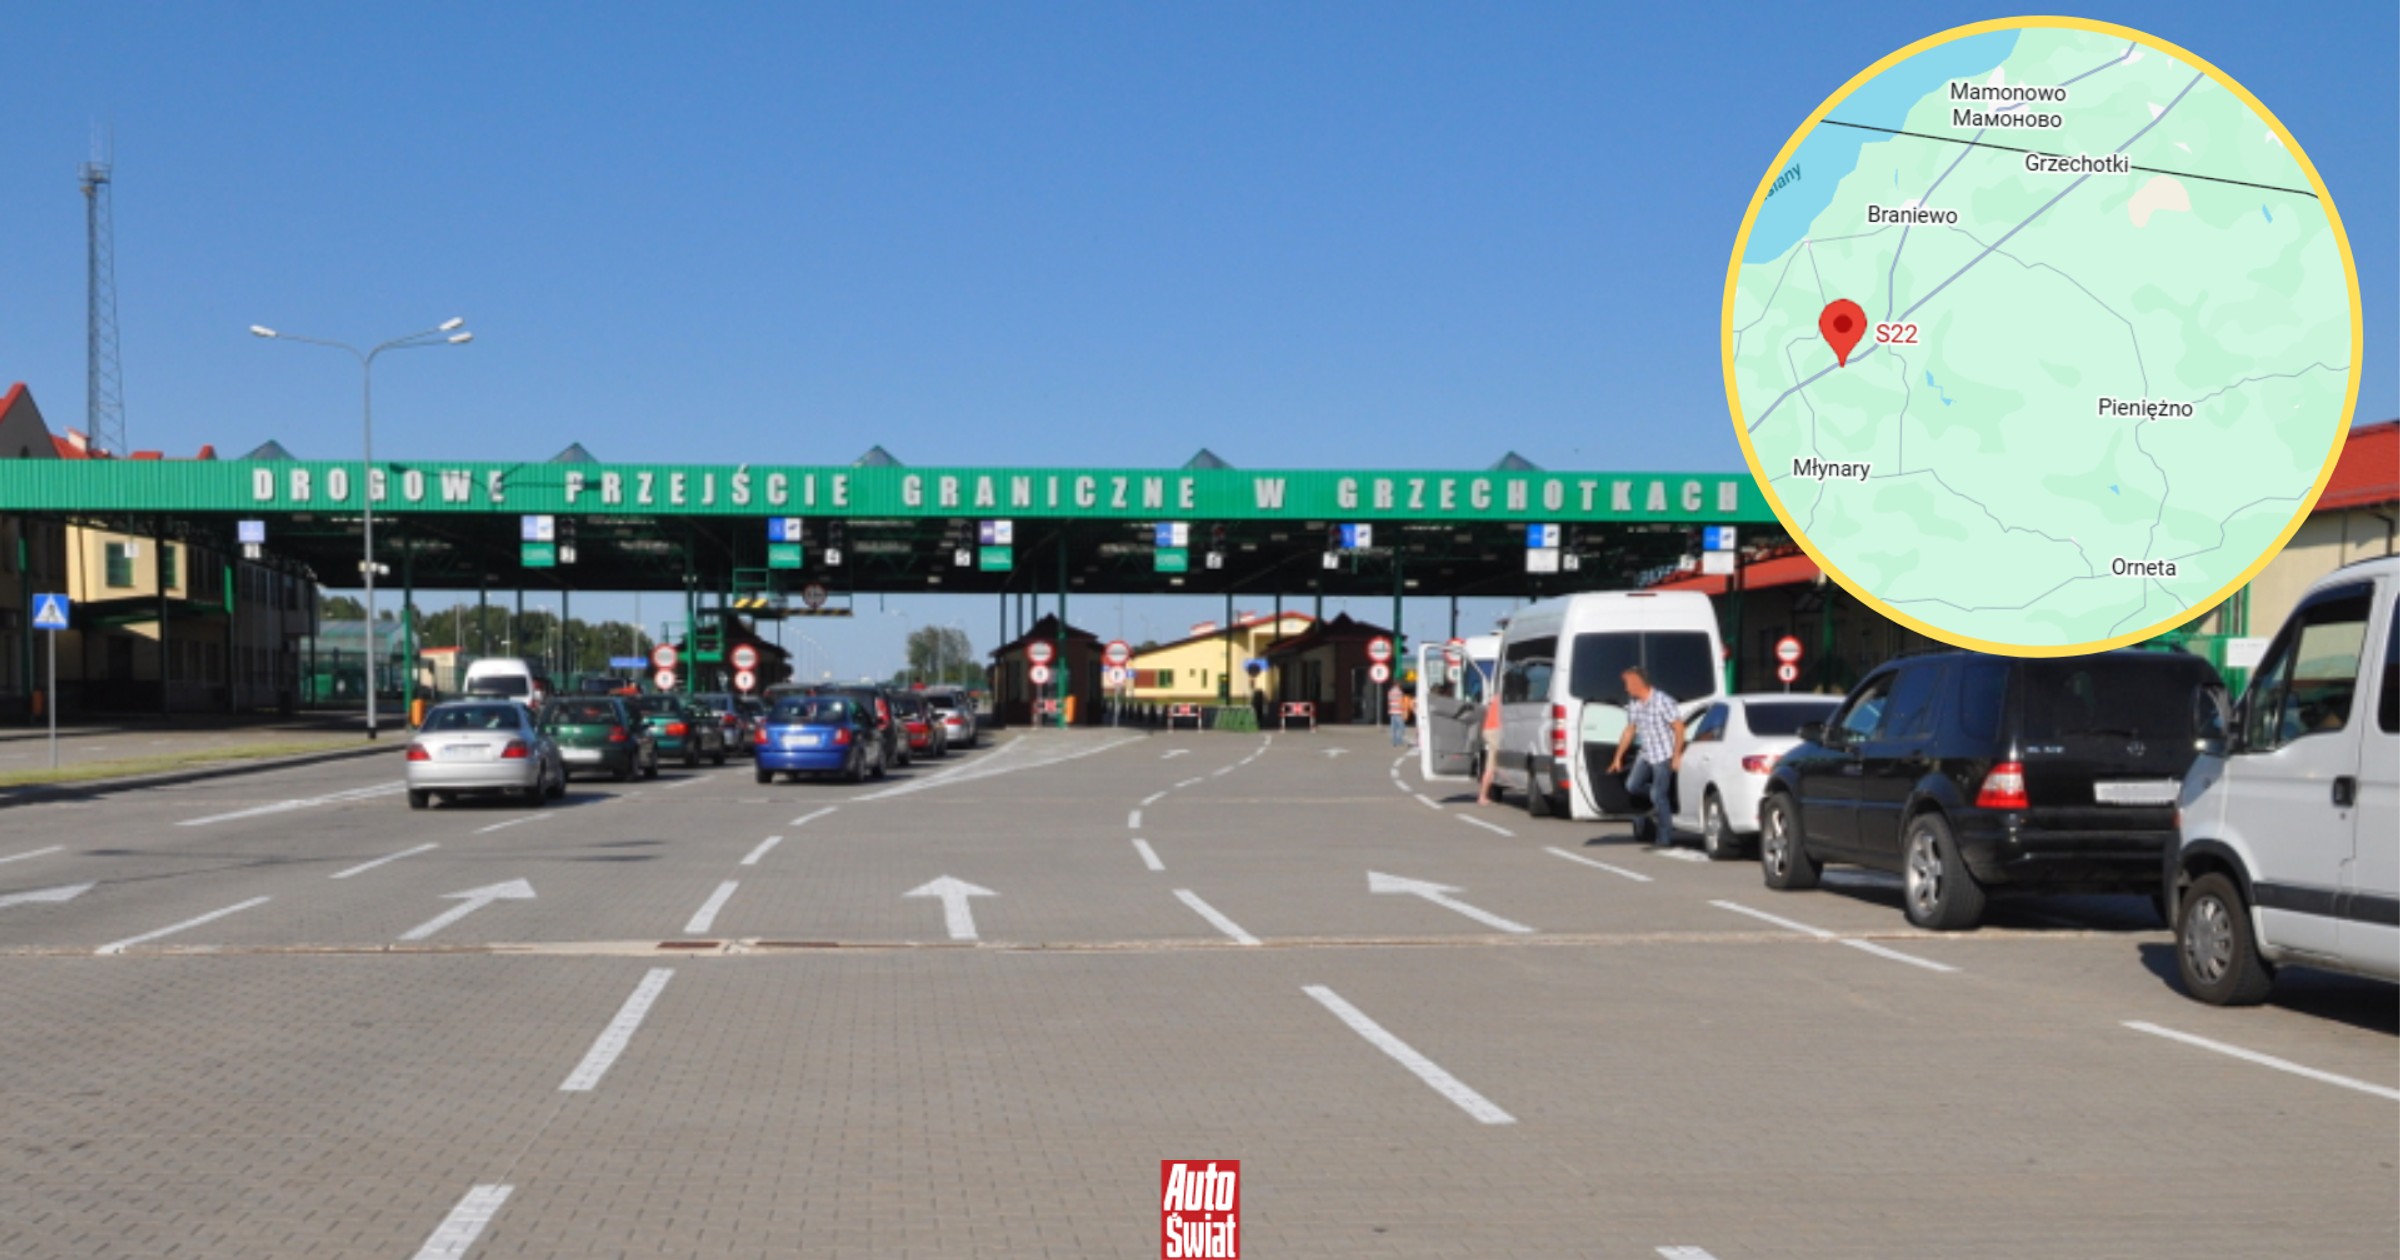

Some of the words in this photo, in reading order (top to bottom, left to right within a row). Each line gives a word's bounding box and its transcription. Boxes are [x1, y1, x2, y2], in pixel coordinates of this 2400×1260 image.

[252, 468, 505, 503] DROGOWE
[565, 463, 848, 505] PRZEJŚCIE
[902, 475, 1194, 508] GRANICZNE
[1255, 479, 1286, 508] W
[1337, 478, 1737, 511] GRZECHOTKACH
